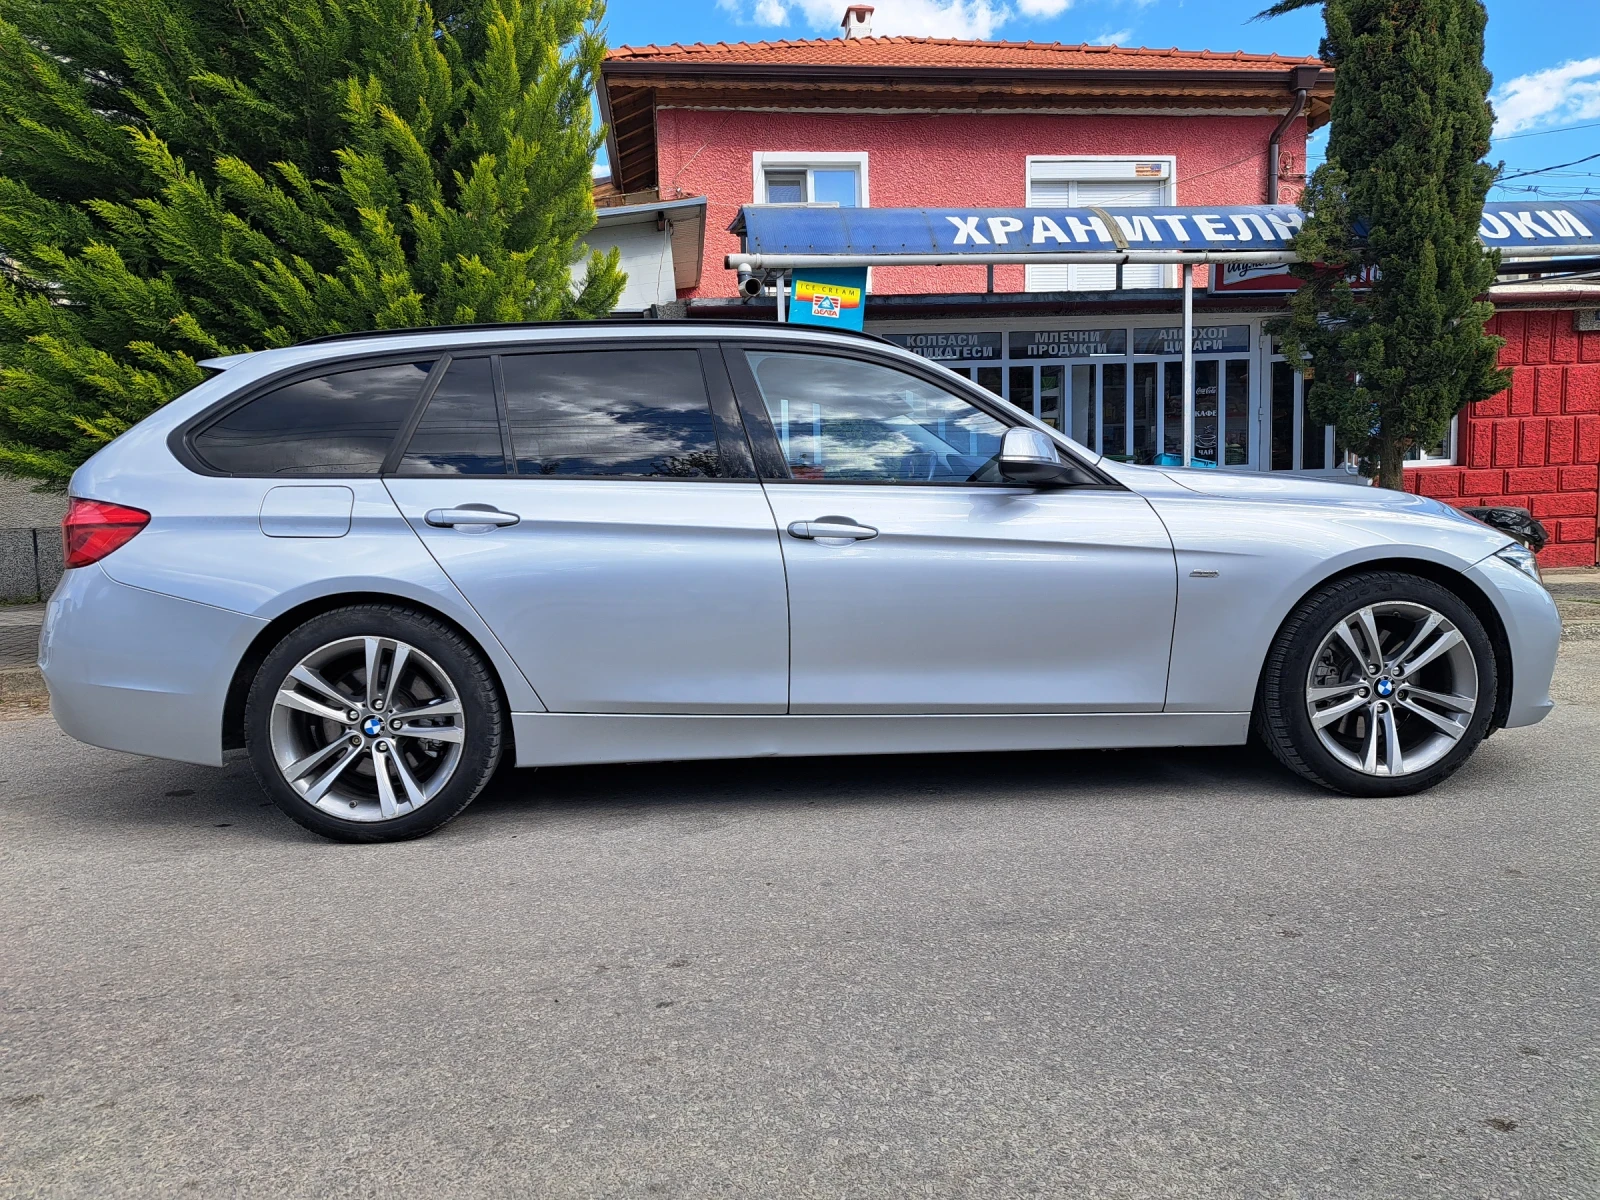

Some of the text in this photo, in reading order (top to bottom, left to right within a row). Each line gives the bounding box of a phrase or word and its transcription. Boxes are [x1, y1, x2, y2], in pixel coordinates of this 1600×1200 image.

[945, 209, 1594, 245] ХРАНИТЕЛН ОКИ
[906, 335, 978, 347] КОЛБАСИ
[1034, 331, 1100, 343] МЛЕЧНИ
[909, 346, 993, 358] ЛИКАТЕСИ
[1027, 343, 1107, 357] ПРОДУКТИ
[1163, 340, 1223, 353] ЦИАРИ
